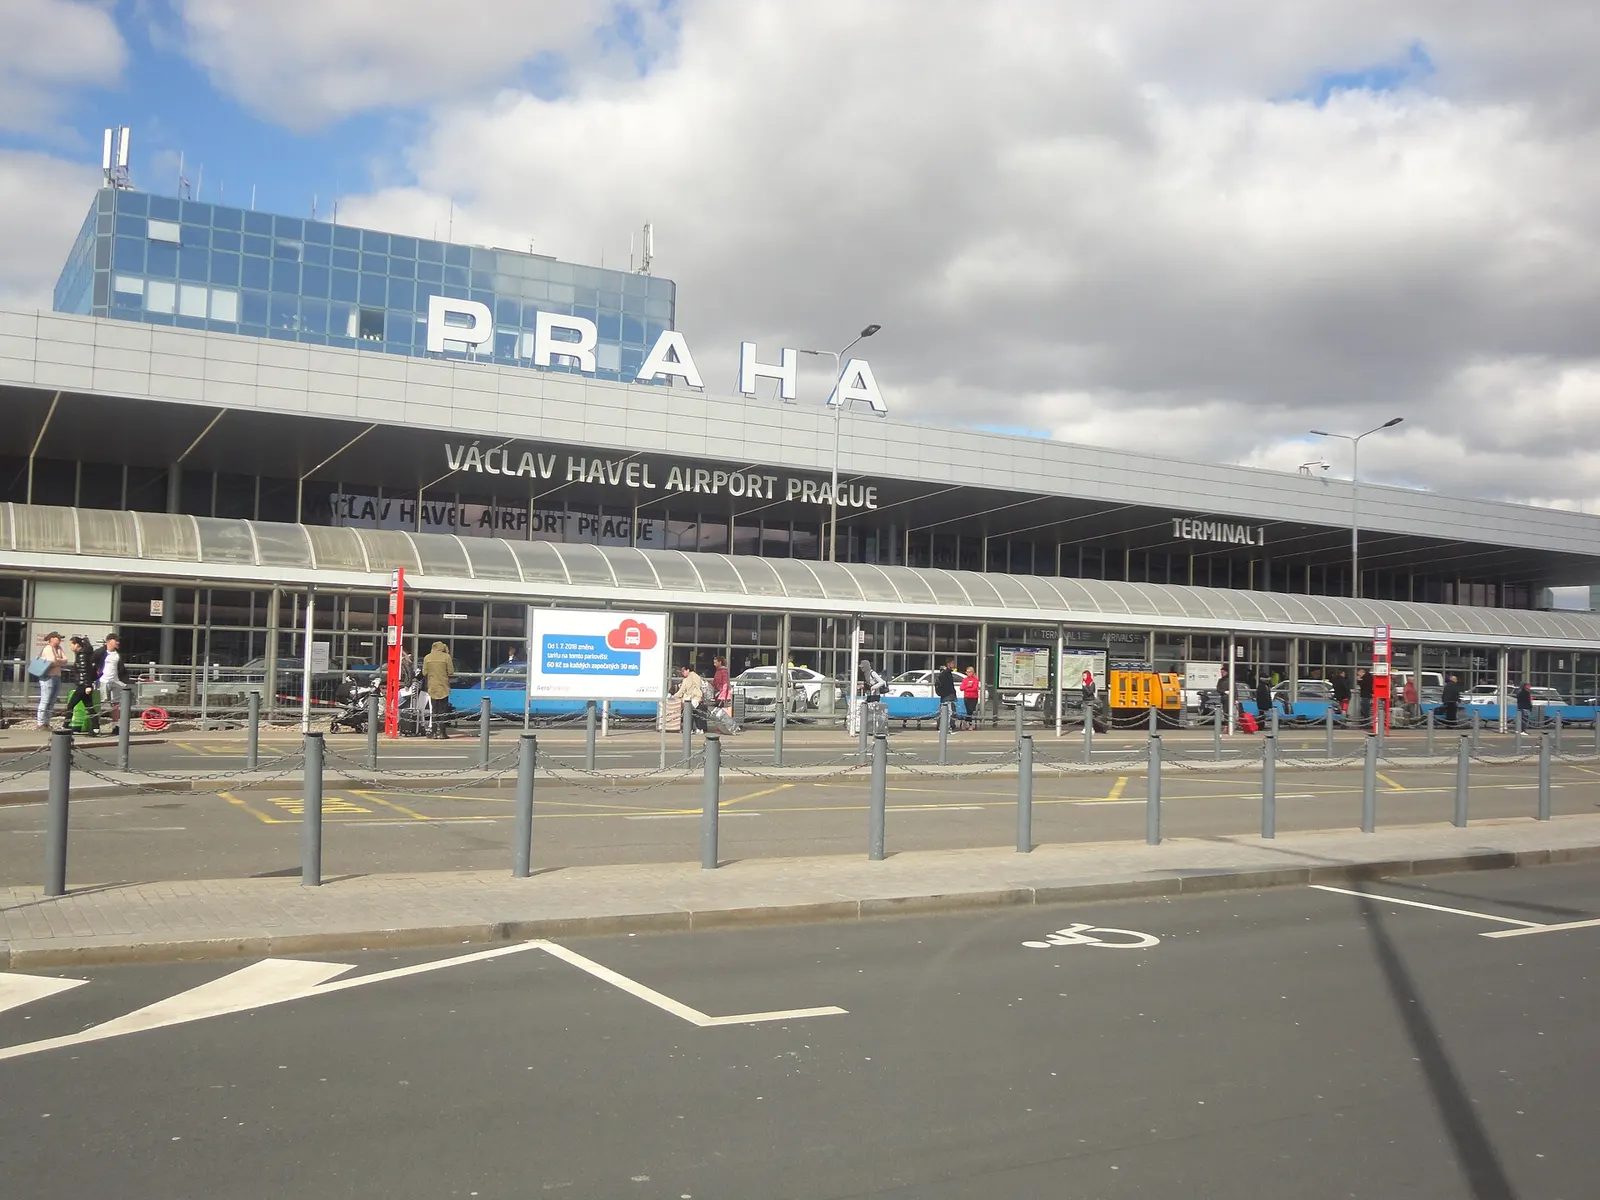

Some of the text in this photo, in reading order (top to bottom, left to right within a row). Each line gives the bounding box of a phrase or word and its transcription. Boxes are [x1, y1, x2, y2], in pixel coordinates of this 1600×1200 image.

[427, 294, 888, 412] PRAHA
[444, 441, 878, 509] VÁCLAV HAVEL AIRPORT PRAGUE
[400, 503, 471, 528] HAVEL
[479, 509, 571, 535] AIRPORT
[1172, 517, 1264, 546] TERMINAL 1
